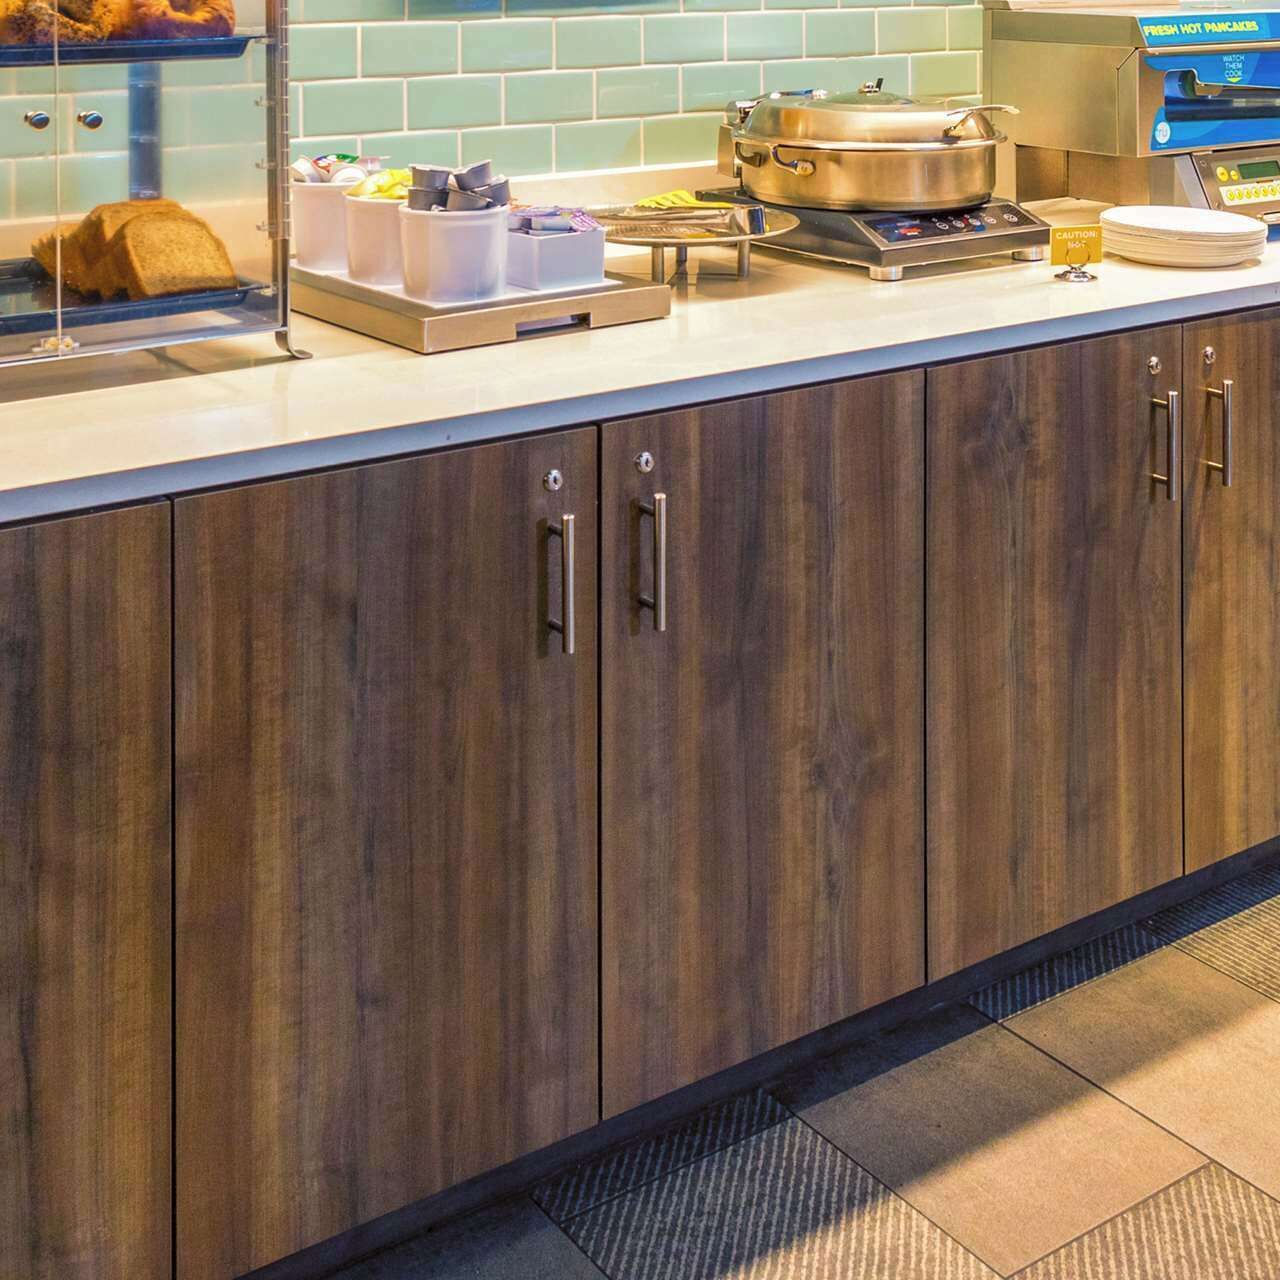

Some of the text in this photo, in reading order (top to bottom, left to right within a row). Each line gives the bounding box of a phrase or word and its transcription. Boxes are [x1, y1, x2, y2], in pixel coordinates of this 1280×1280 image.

[1142, 20, 1259, 37] FRESH HOT PANCAKES
[1223, 54, 1245, 62] WATCH
[1224, 70, 1243, 78] COOK
